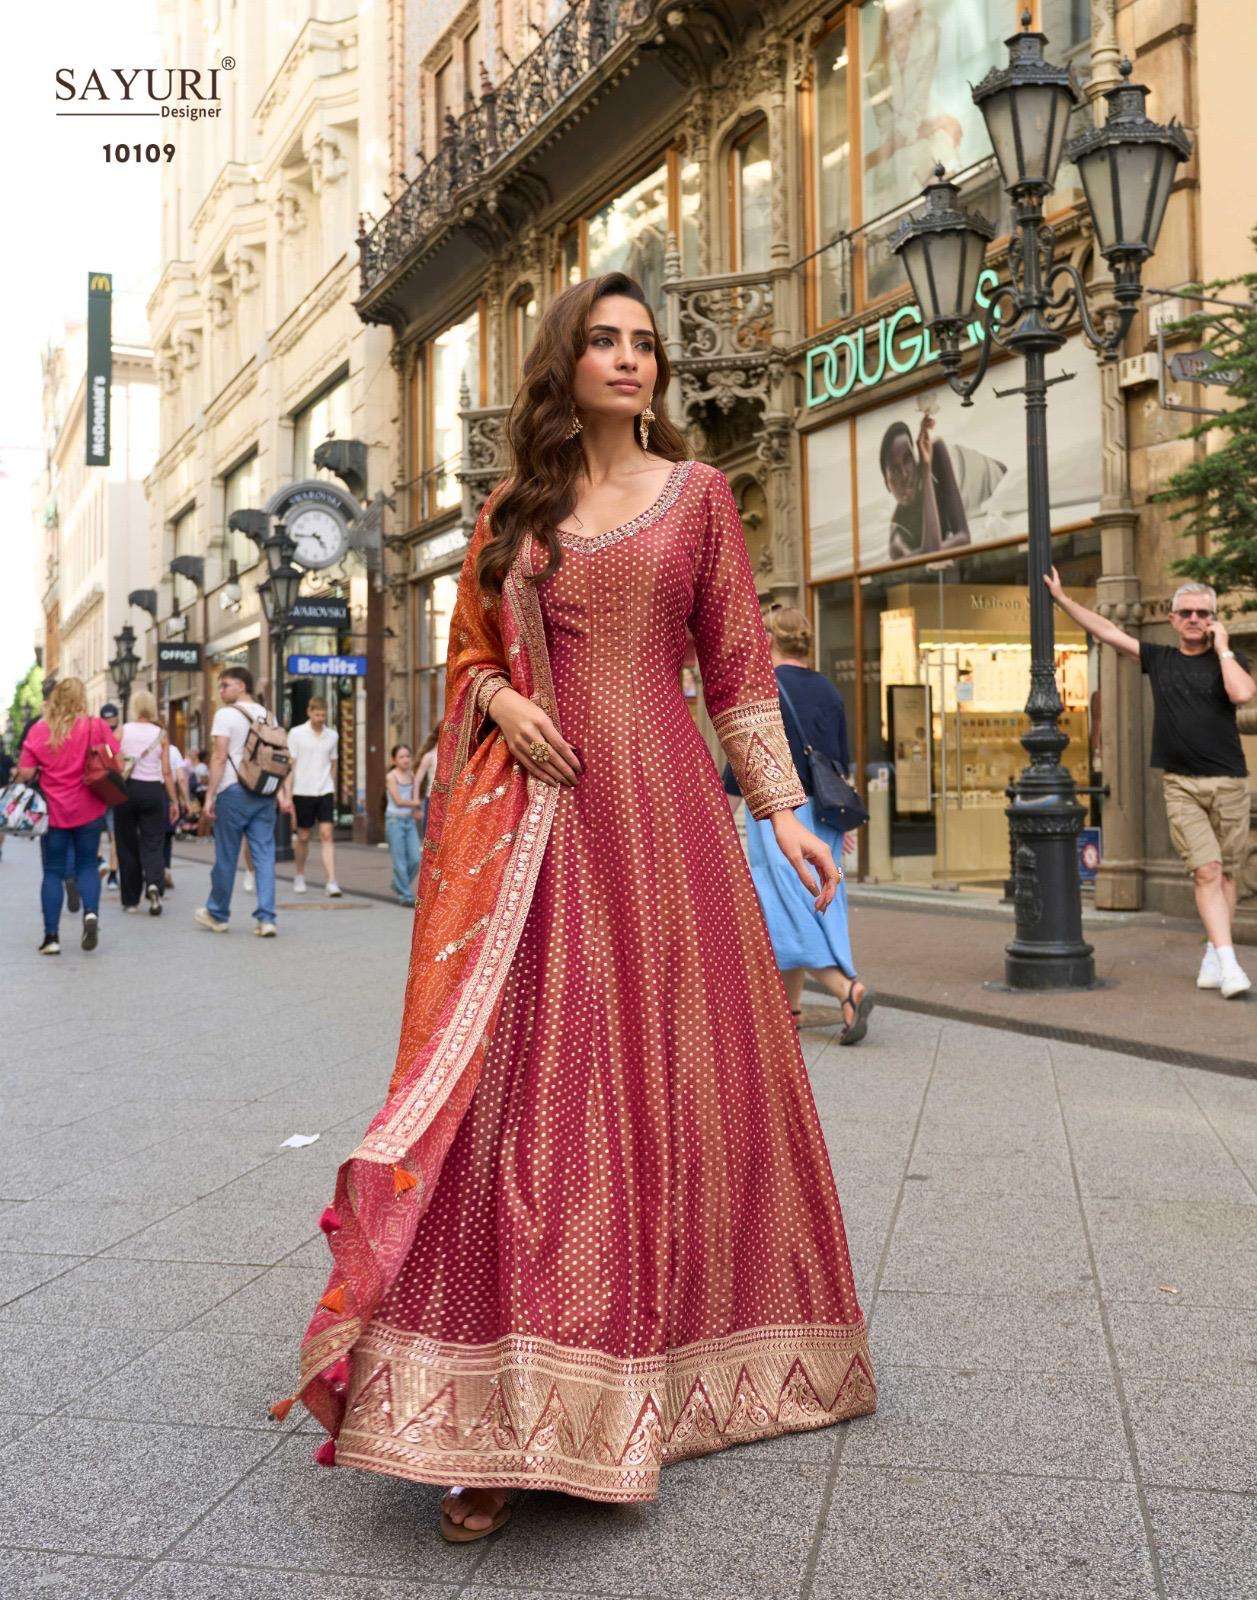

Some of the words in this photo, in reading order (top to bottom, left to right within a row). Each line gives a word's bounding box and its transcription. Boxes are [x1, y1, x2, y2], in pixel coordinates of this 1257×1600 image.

[806, 269, 1000, 408] DOUGLS
[160, 650, 197, 661] OFFICE
[298, 658, 358, 675] Berlitz
